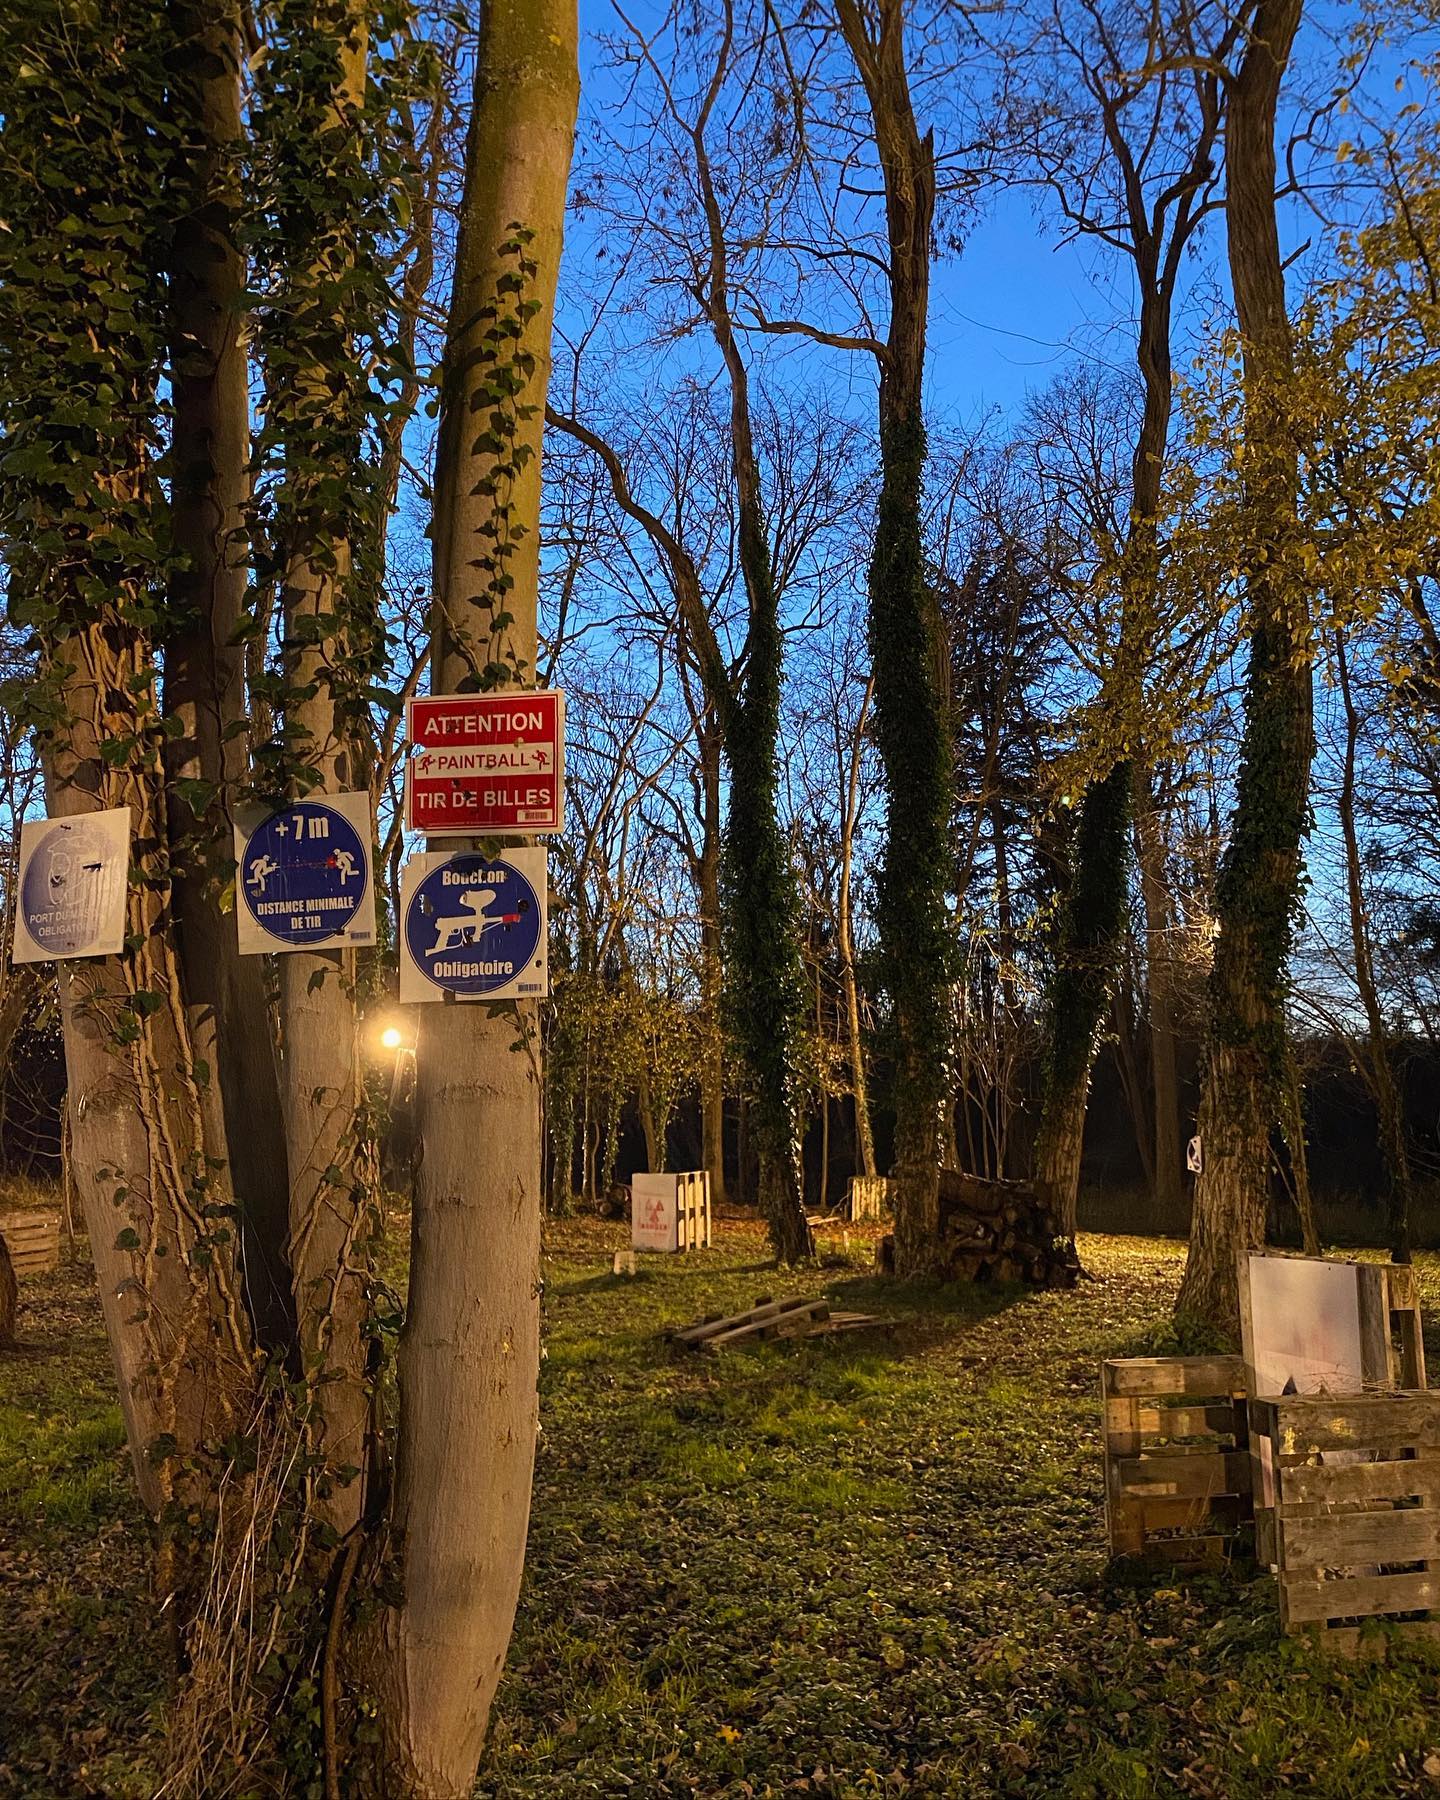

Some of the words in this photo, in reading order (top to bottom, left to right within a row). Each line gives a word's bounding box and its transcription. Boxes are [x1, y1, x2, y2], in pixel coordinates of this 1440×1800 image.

[424, 712, 543, 735] ATTENTION
[438, 753, 529, 770] PAINTBALL
[417, 792, 446, 809] TIR
[453, 791, 477, 807] DE
[484, 788, 551, 806] BILLES
[257, 901, 305, 916] DISTANCE
[306, 896, 354, 913] MINIMALE
[30, 912, 54, 924] PORT
[291, 917, 305, 930] DE
[305, 915, 321, 929] TIR
[433, 960, 513, 978] Obligatoire
